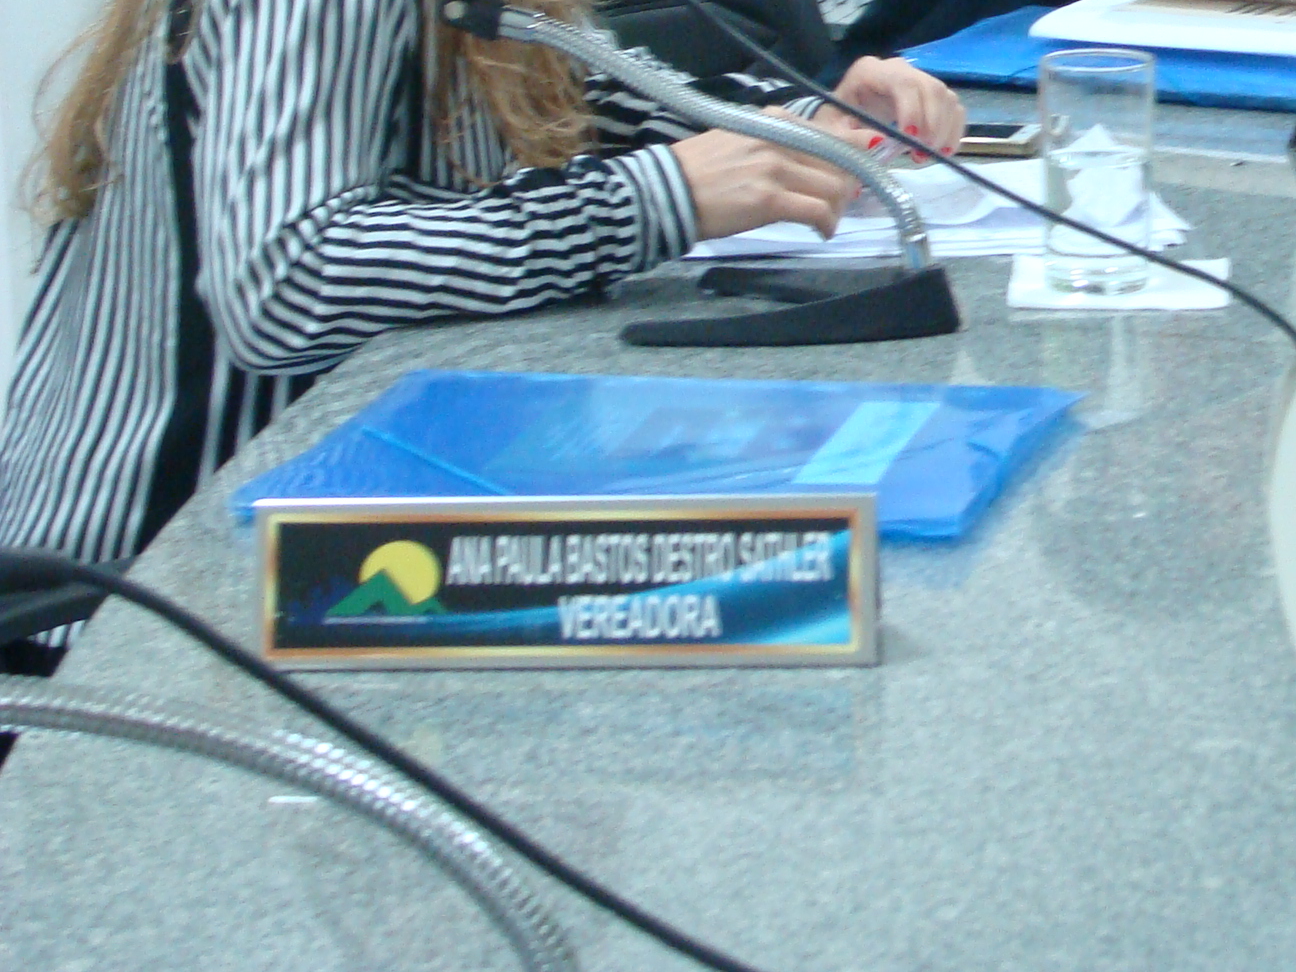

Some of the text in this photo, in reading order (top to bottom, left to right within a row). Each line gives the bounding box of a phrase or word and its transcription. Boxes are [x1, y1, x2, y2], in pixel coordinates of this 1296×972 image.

[446, 536, 493, 585] ANA
[495, 535, 562, 585] PAULA
[566, 534, 648, 584] BASTOS
[652, 533, 734, 583] DESTRO
[557, 595, 723, 639] VEREADORA
